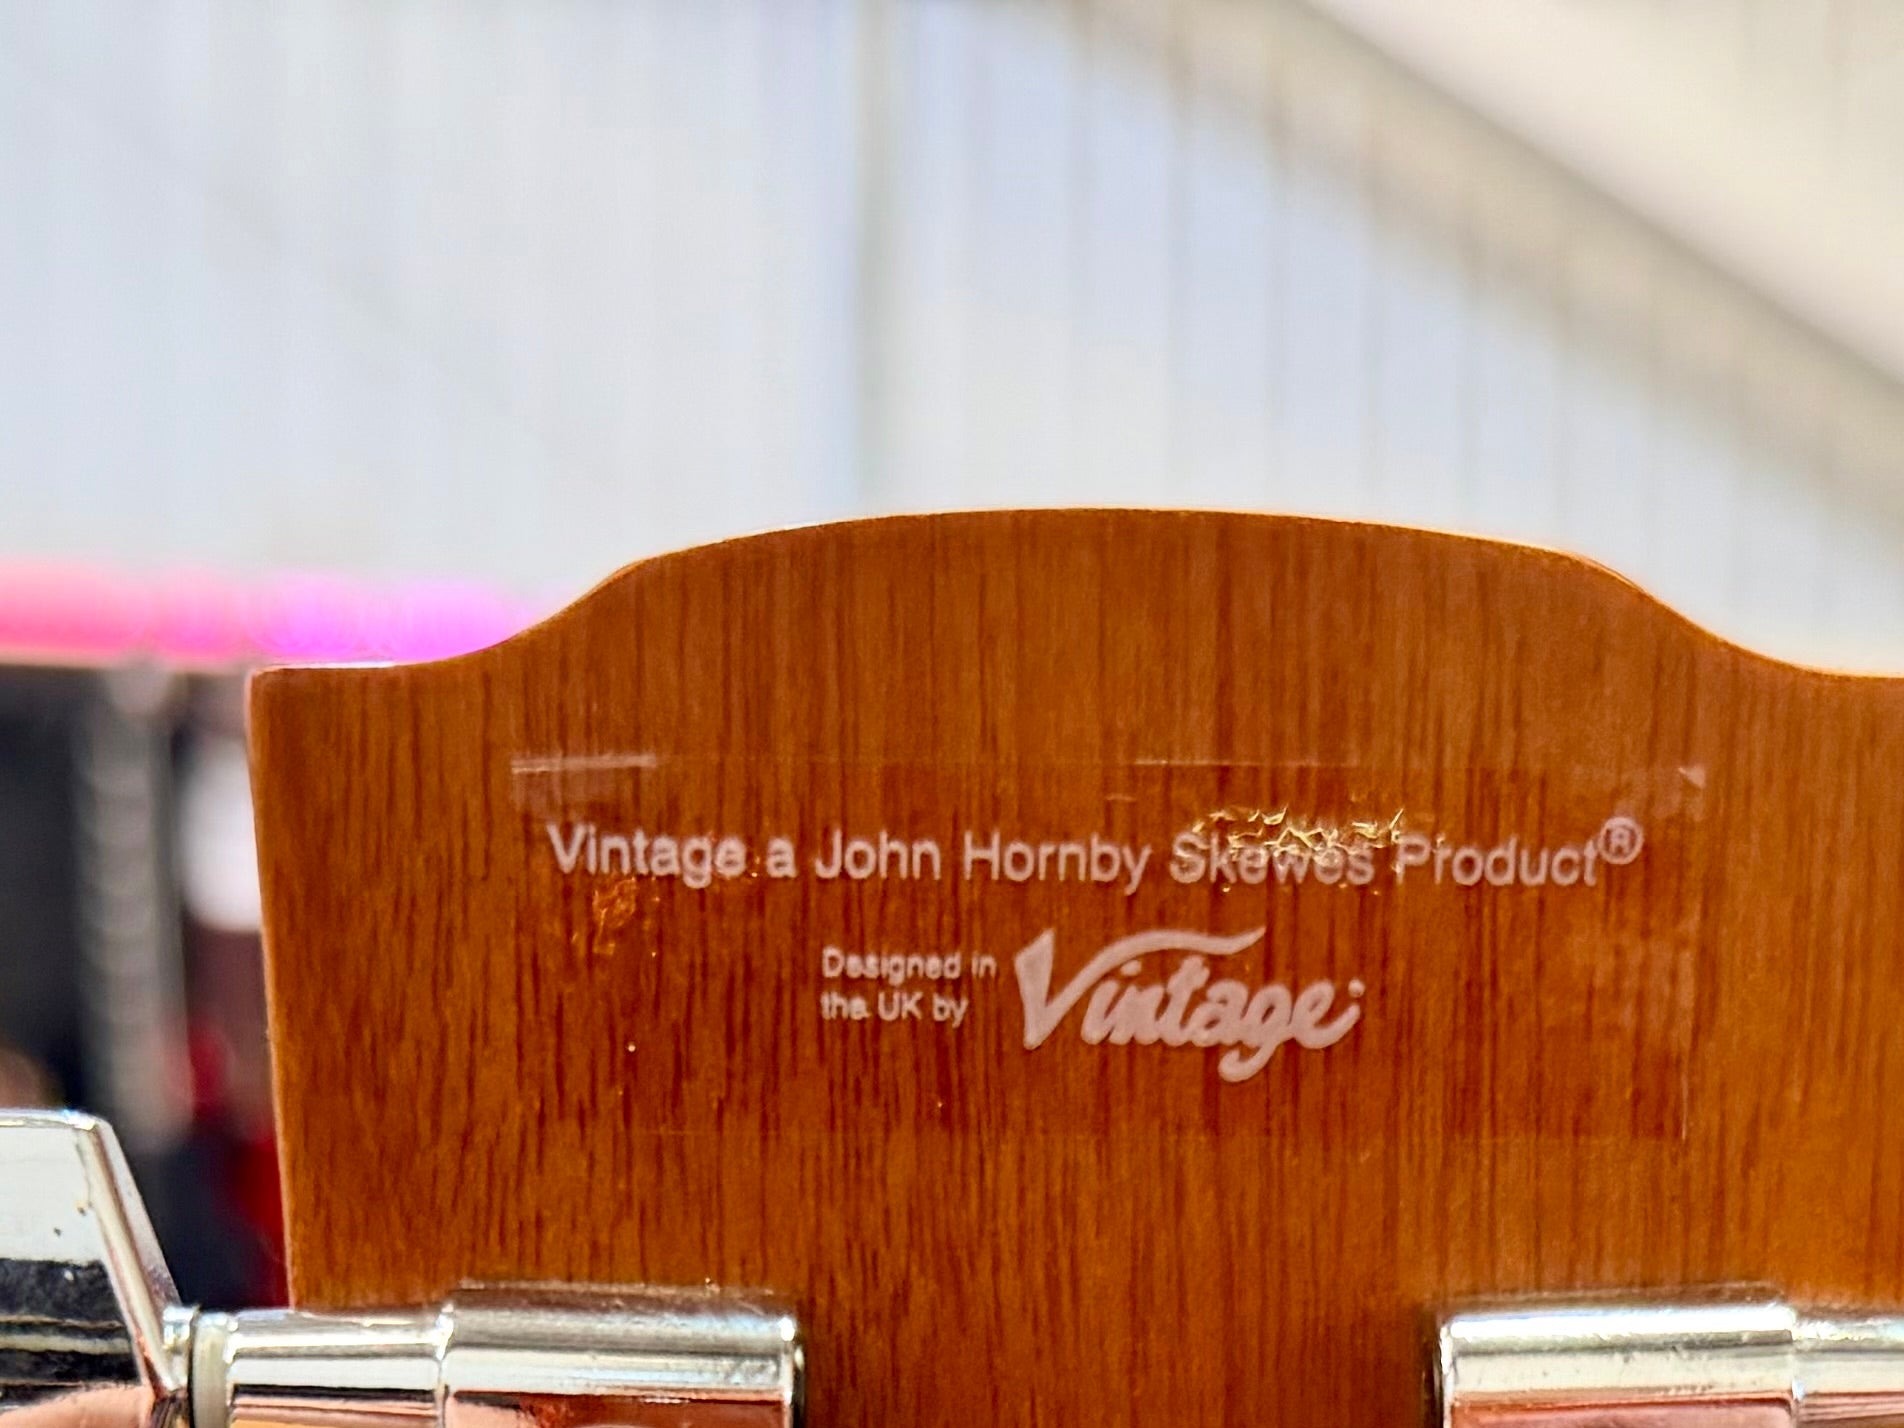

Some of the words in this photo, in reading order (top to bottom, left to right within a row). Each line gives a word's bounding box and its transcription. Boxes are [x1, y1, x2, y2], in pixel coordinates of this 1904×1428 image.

[545, 821, 748, 889] Vintage
[764, 838, 796, 879] a
[814, 827, 942, 882] John
[963, 829, 1152, 896] Hornby
[1169, 830, 1376, 886] Skewes
[821, 944, 963, 987] Designed
[970, 950, 998, 979] in
[819, 990, 873, 1021] the
[877, 990, 925, 1022] UK
[931, 991, 970, 1029] by
[1012, 925, 1364, 1083] Vintage
